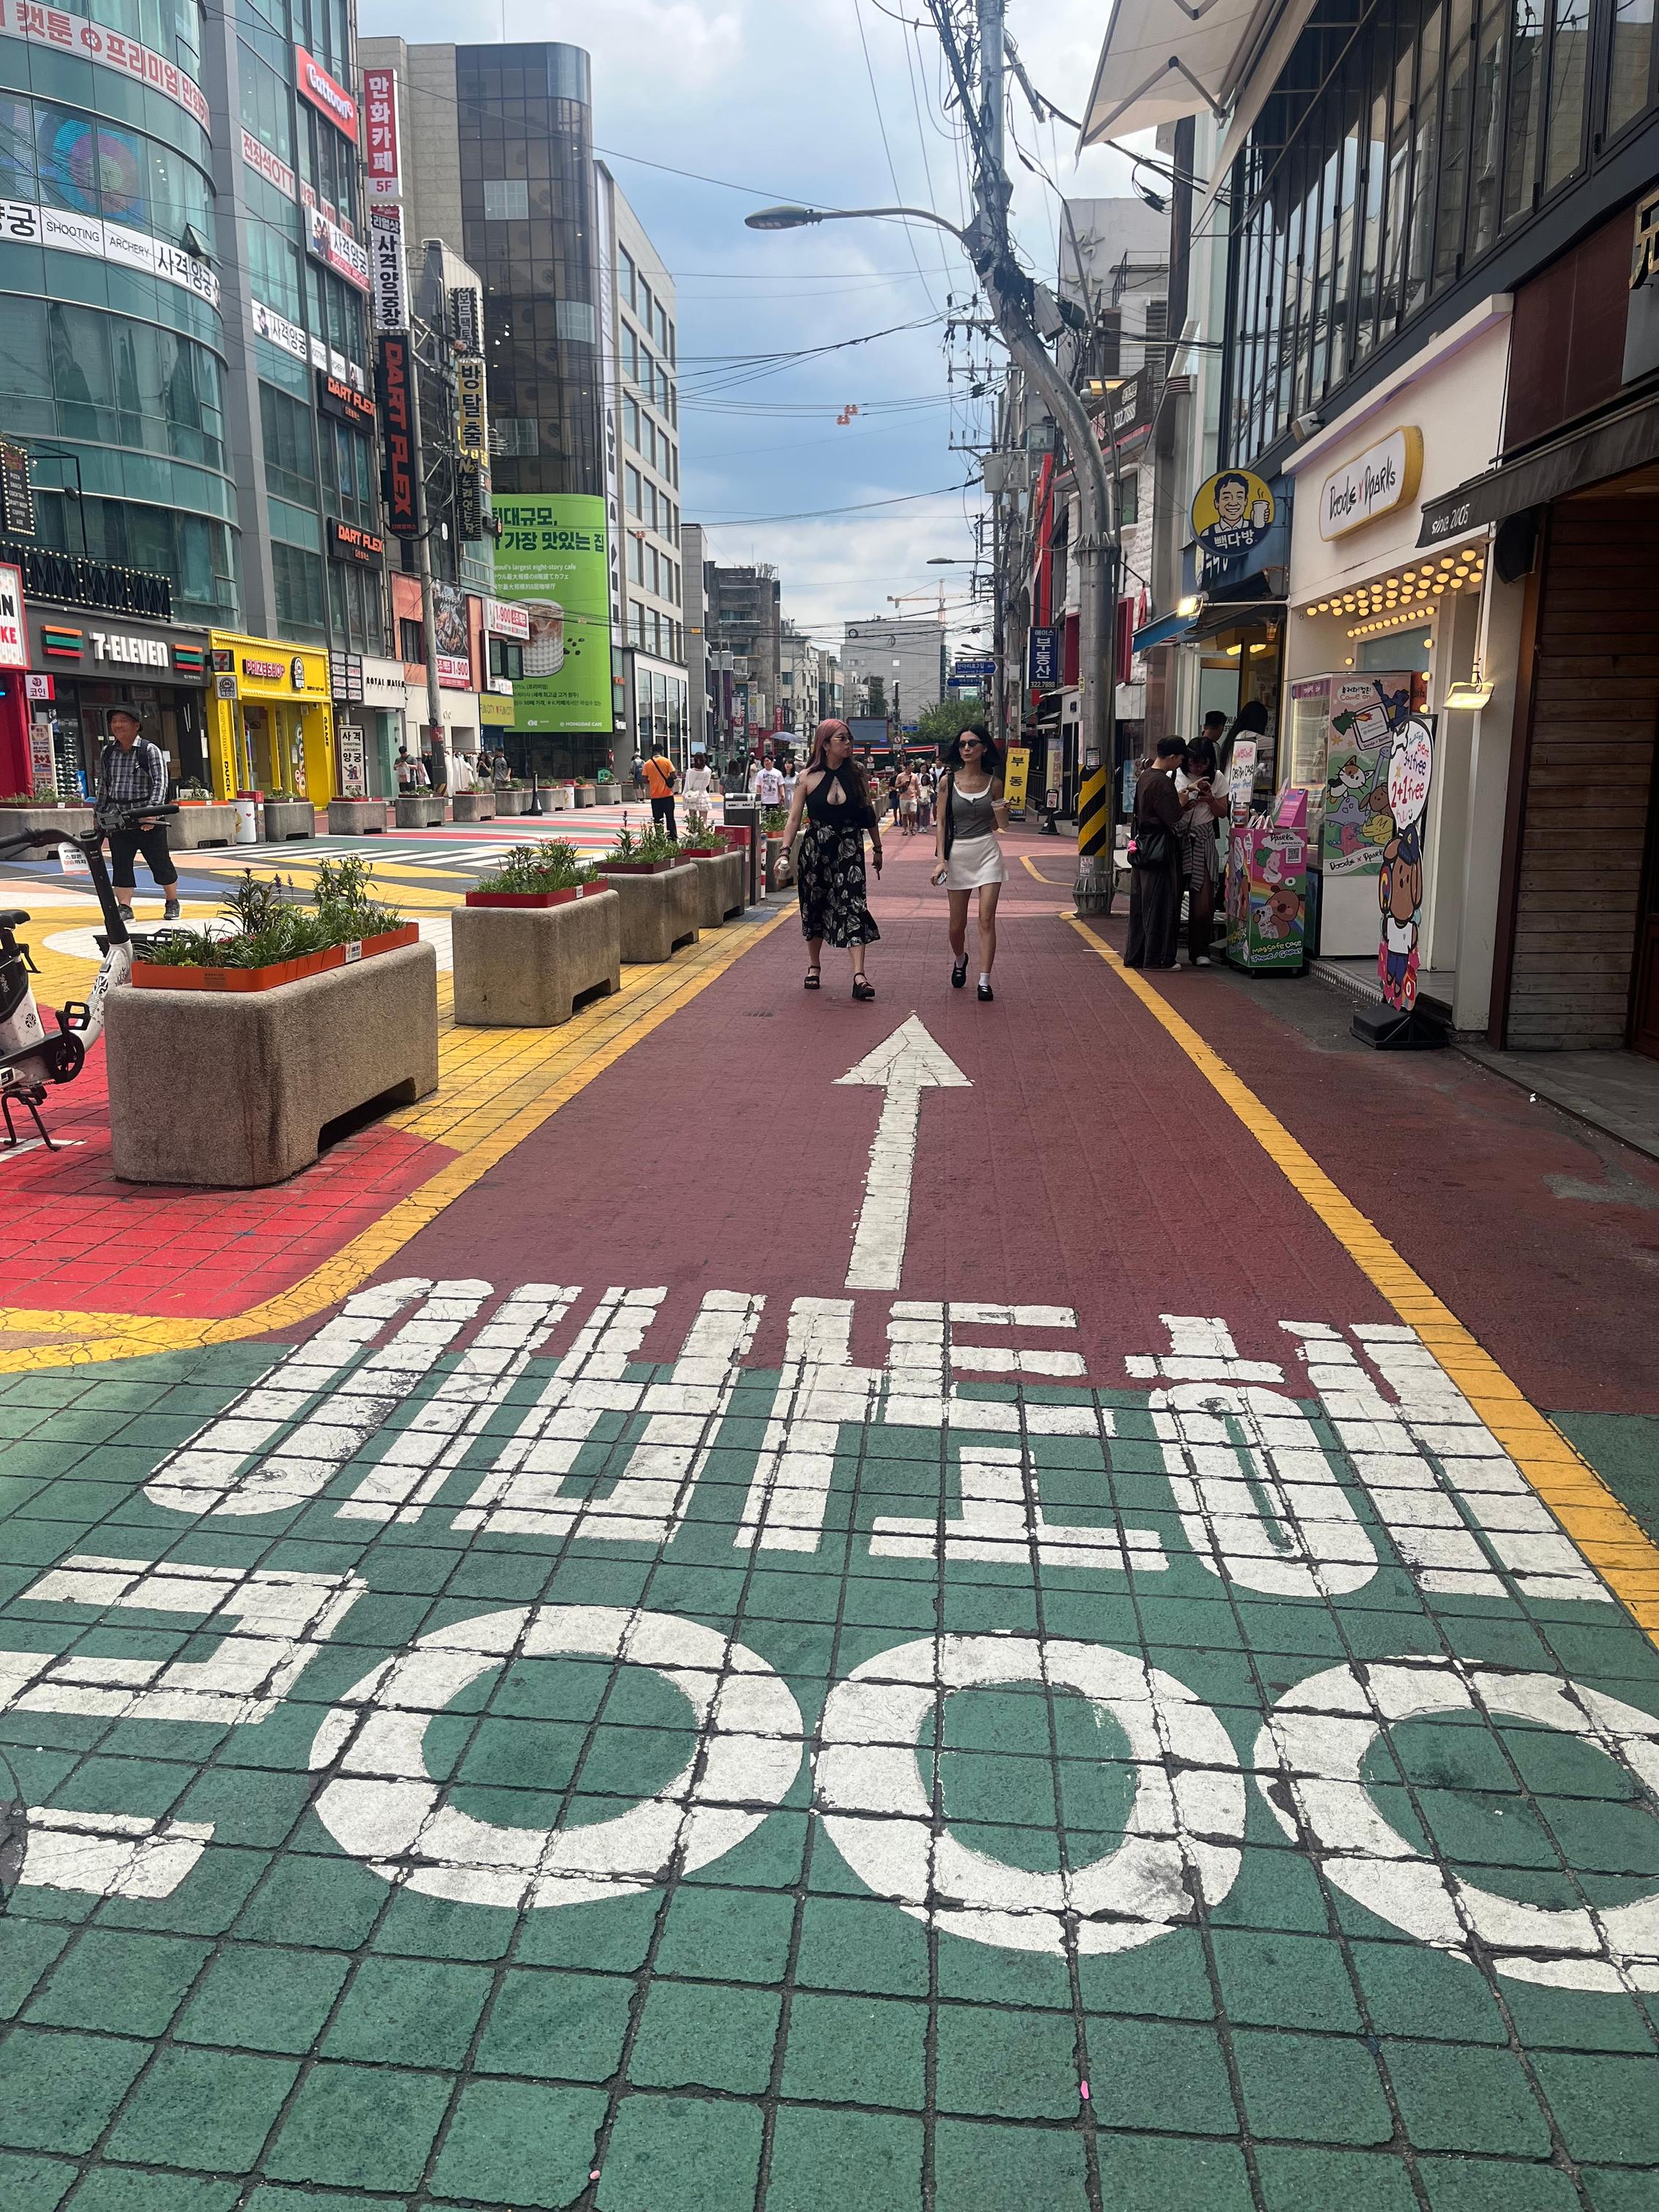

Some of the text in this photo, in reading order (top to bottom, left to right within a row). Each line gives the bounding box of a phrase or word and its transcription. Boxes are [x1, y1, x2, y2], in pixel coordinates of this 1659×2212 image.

[16, 1, 72, 46] 캣툰
[106, 33, 178, 97] 프리미엄
[368, 76, 393, 173] 만화카페
[376, 181, 392, 192] 5F
[46, 221, 150, 258] SHOOTING ARCHERY
[157, 247, 212, 297] 사격양궁
[377, 235, 402, 326] 사격양궁장
[327, 377, 352, 403] DART
[385, 341, 407, 430] DART
[461, 364, 483, 448] 방탈출
[338, 524, 361, 546] DART
[1431, 503, 1470, 535] since 2005
[505, 532, 538, 551] 가장
[542, 532, 590, 551] 맛있는
[594, 533, 604, 553] 집
[1214, 529, 1254, 549] 빽다방
[89, 631, 170, 668] 7-ELEVEN
[1035, 637, 1051, 679] 부동산
[30, 688, 46, 697] 코인
[366, 677, 385, 686] ROYAL
[342, 731, 361, 742] 사격
[343, 753, 361, 762] 양궁
[1009, 756, 1024, 806] 부동산
